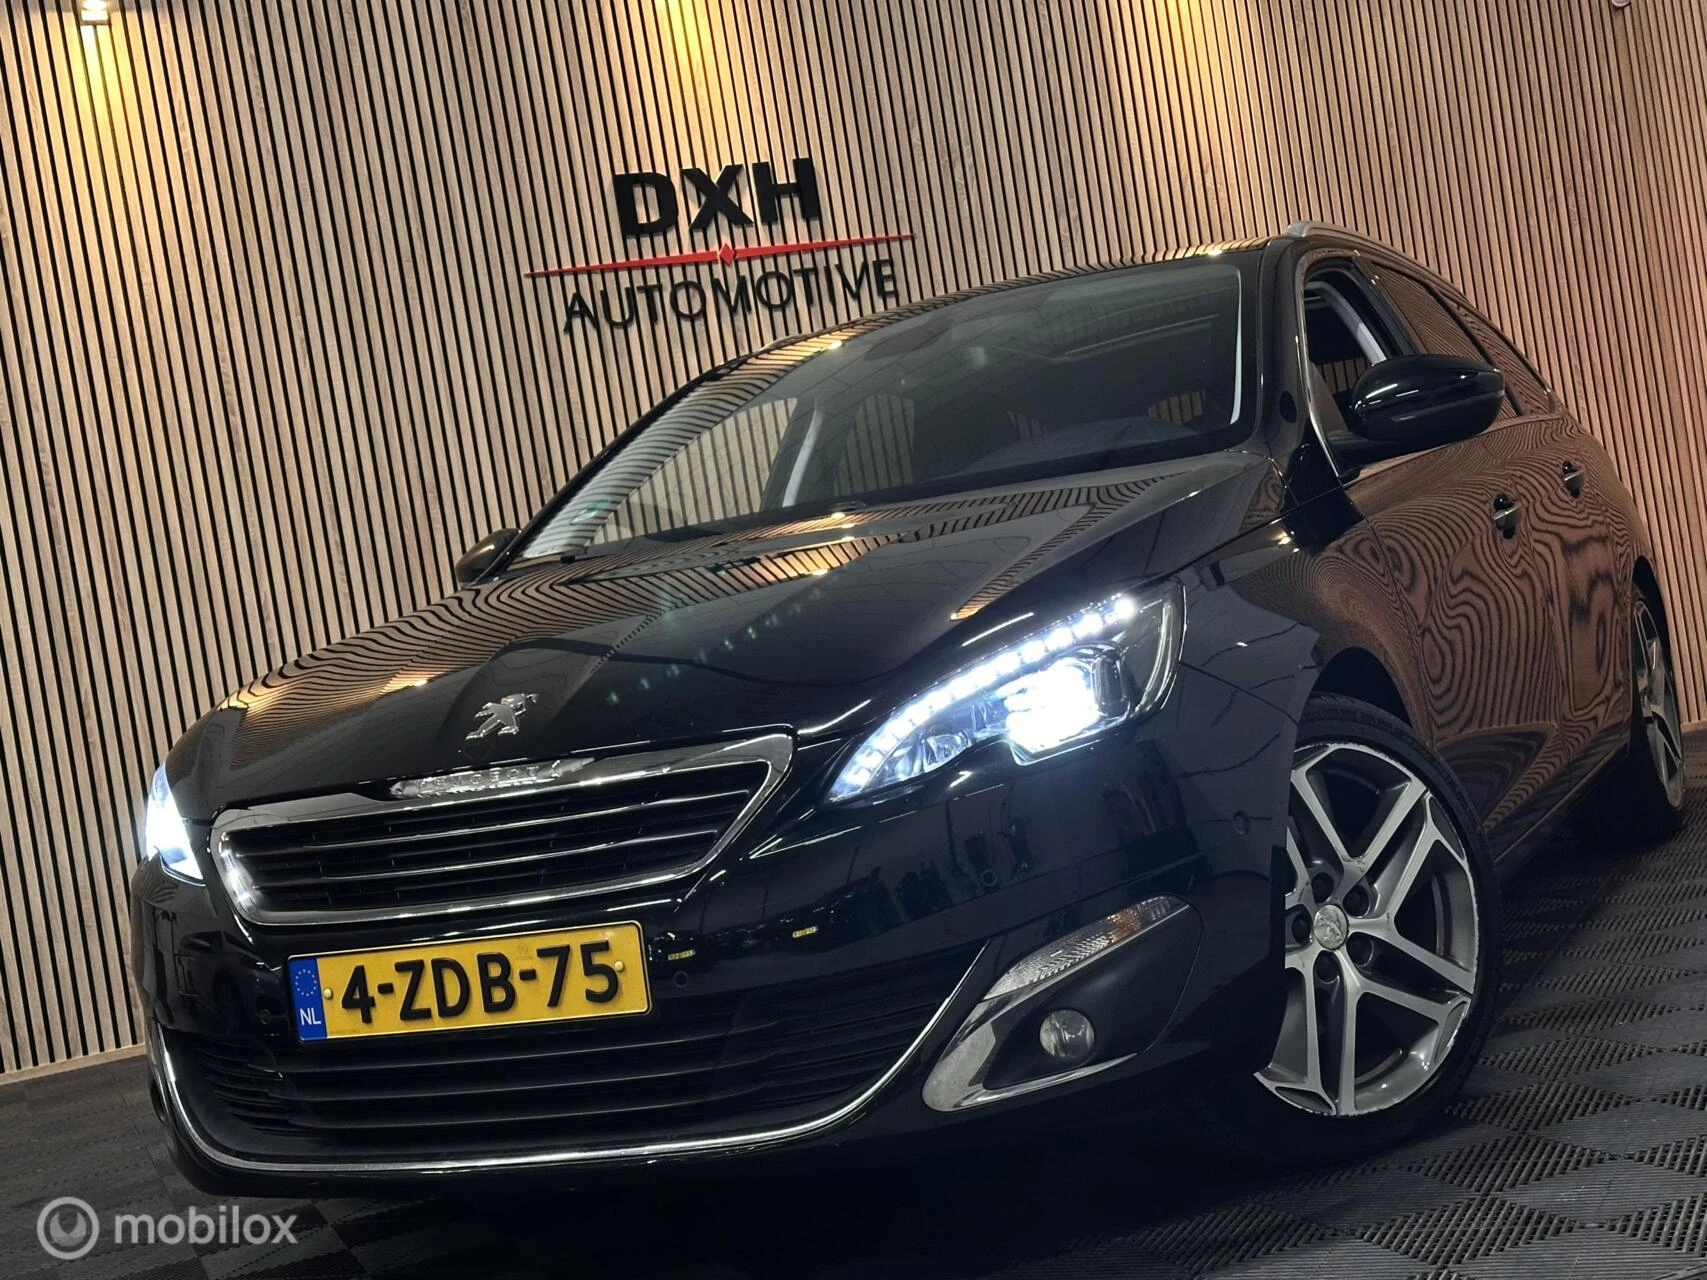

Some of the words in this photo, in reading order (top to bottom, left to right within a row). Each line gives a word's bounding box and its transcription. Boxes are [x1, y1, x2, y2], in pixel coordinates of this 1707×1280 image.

[613, 158, 821, 237] DXH
[563, 258, 899, 334] AUTOMOTIVE
[299, 1007, 322, 1027] NL
[341, 940, 620, 1025] 4-ZDB-75
